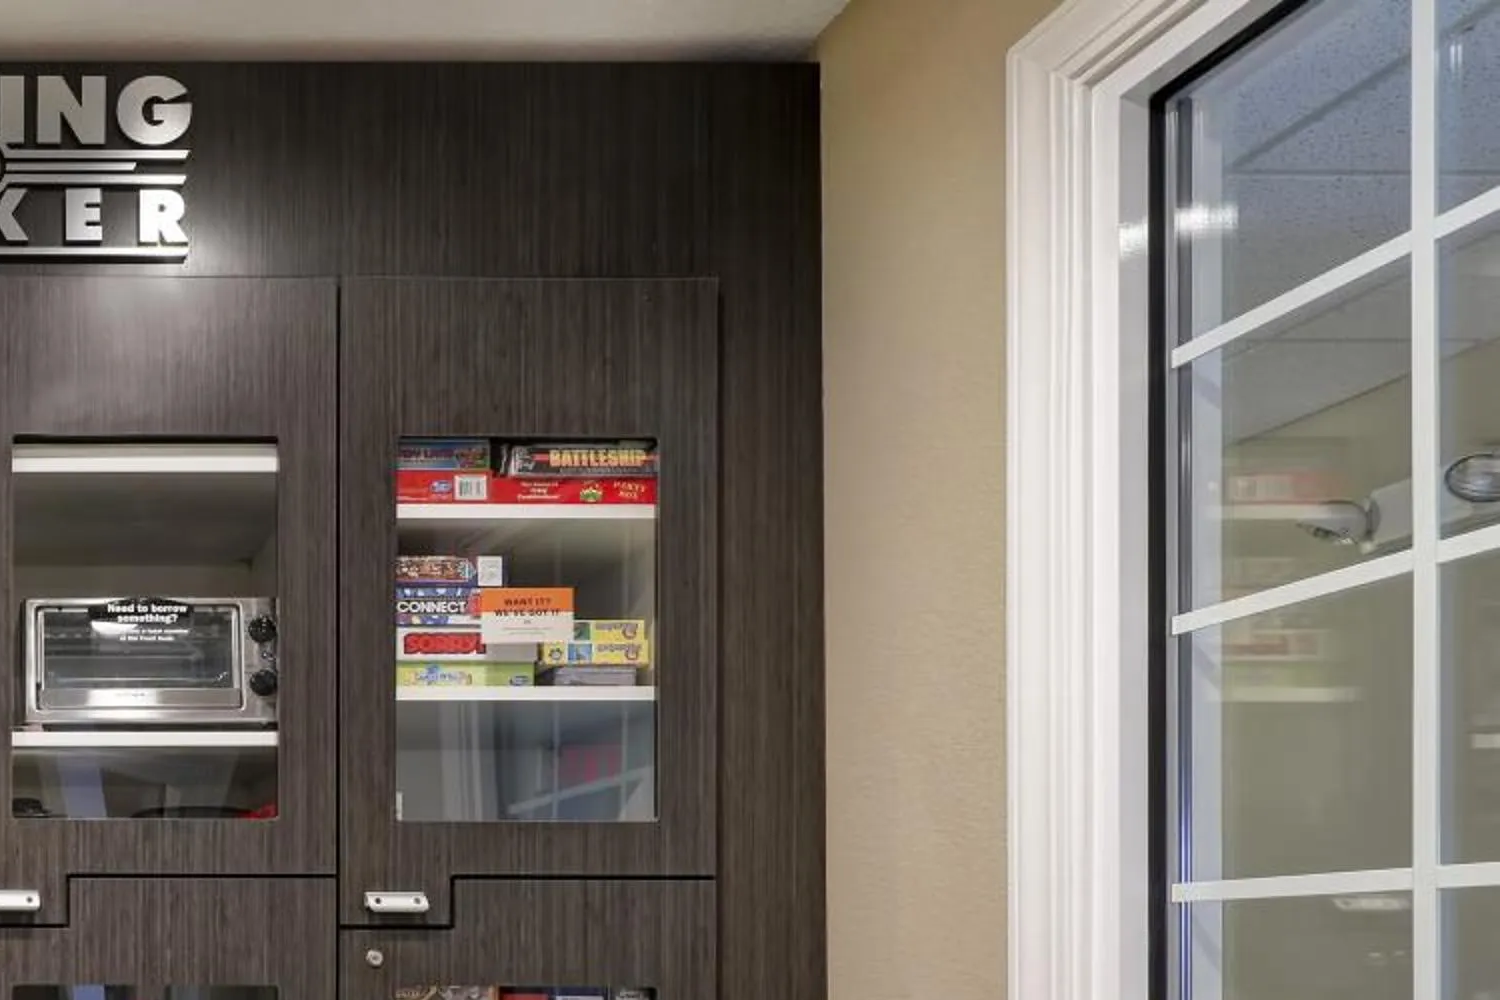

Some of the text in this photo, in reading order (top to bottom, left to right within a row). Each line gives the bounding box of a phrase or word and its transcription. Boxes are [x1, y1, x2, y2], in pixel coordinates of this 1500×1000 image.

[550, 449, 646, 467] BATTLESHIP
[107, 603, 188, 613] Need to borrow
[396, 601, 467, 613] CONNECT
[117, 614, 179, 624] something?
